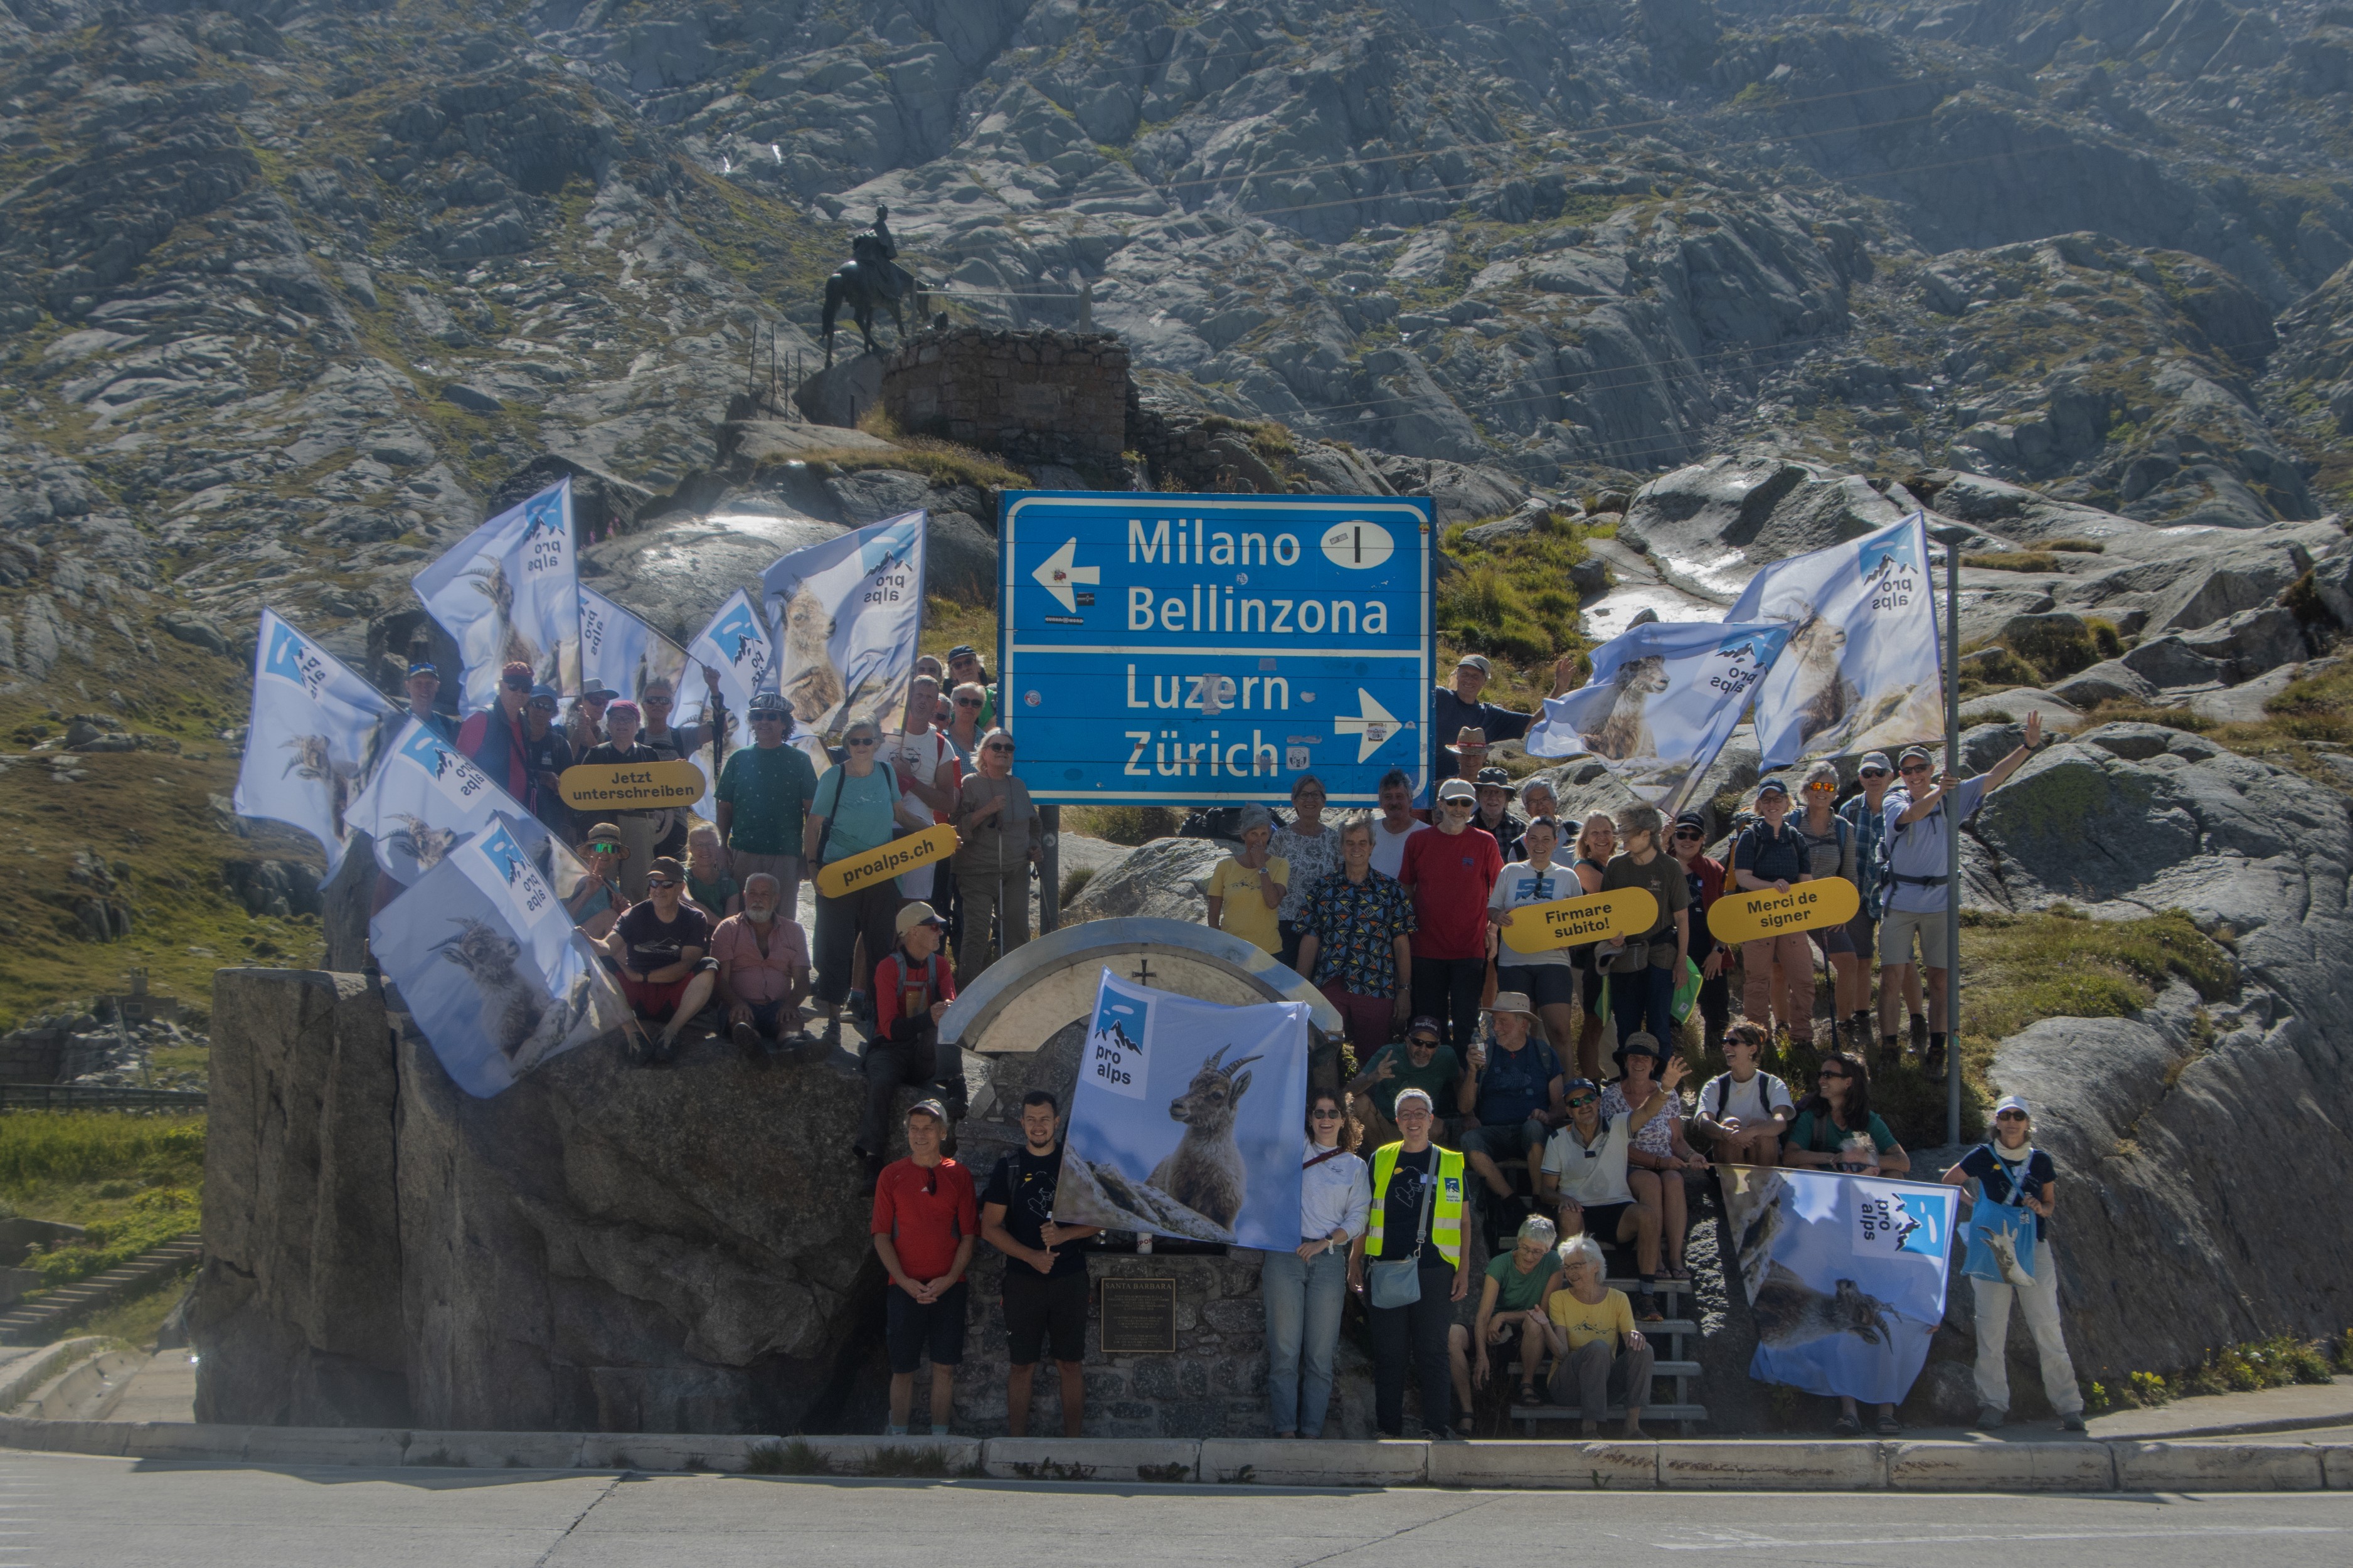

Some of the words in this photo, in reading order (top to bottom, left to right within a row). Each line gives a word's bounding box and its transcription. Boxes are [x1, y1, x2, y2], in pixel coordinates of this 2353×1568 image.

[1129, 518, 1300, 566] Milano
[1128, 584, 1388, 634] Bellinzona
[1127, 664, 1289, 710] Luzern
[1124, 729, 1278, 777] Zürich
[611, 771, 652, 784] Jetzt
[573, 785, 694, 800] unterschreiben
[843, 839, 935, 886] proalps.ch
[1545, 904, 1612, 924] Firmare
[1747, 894, 1794, 914] Merci
[1798, 892, 1817, 904] de
[1555, 917, 1610, 938] subito!
[1760, 910, 1811, 928] signer
[1096, 1044, 1121, 1064] pro
[1097, 1062, 1131, 1084] alps
[1859, 1204, 1875, 1241] alps
[1874, 1200, 1890, 1231] pro
